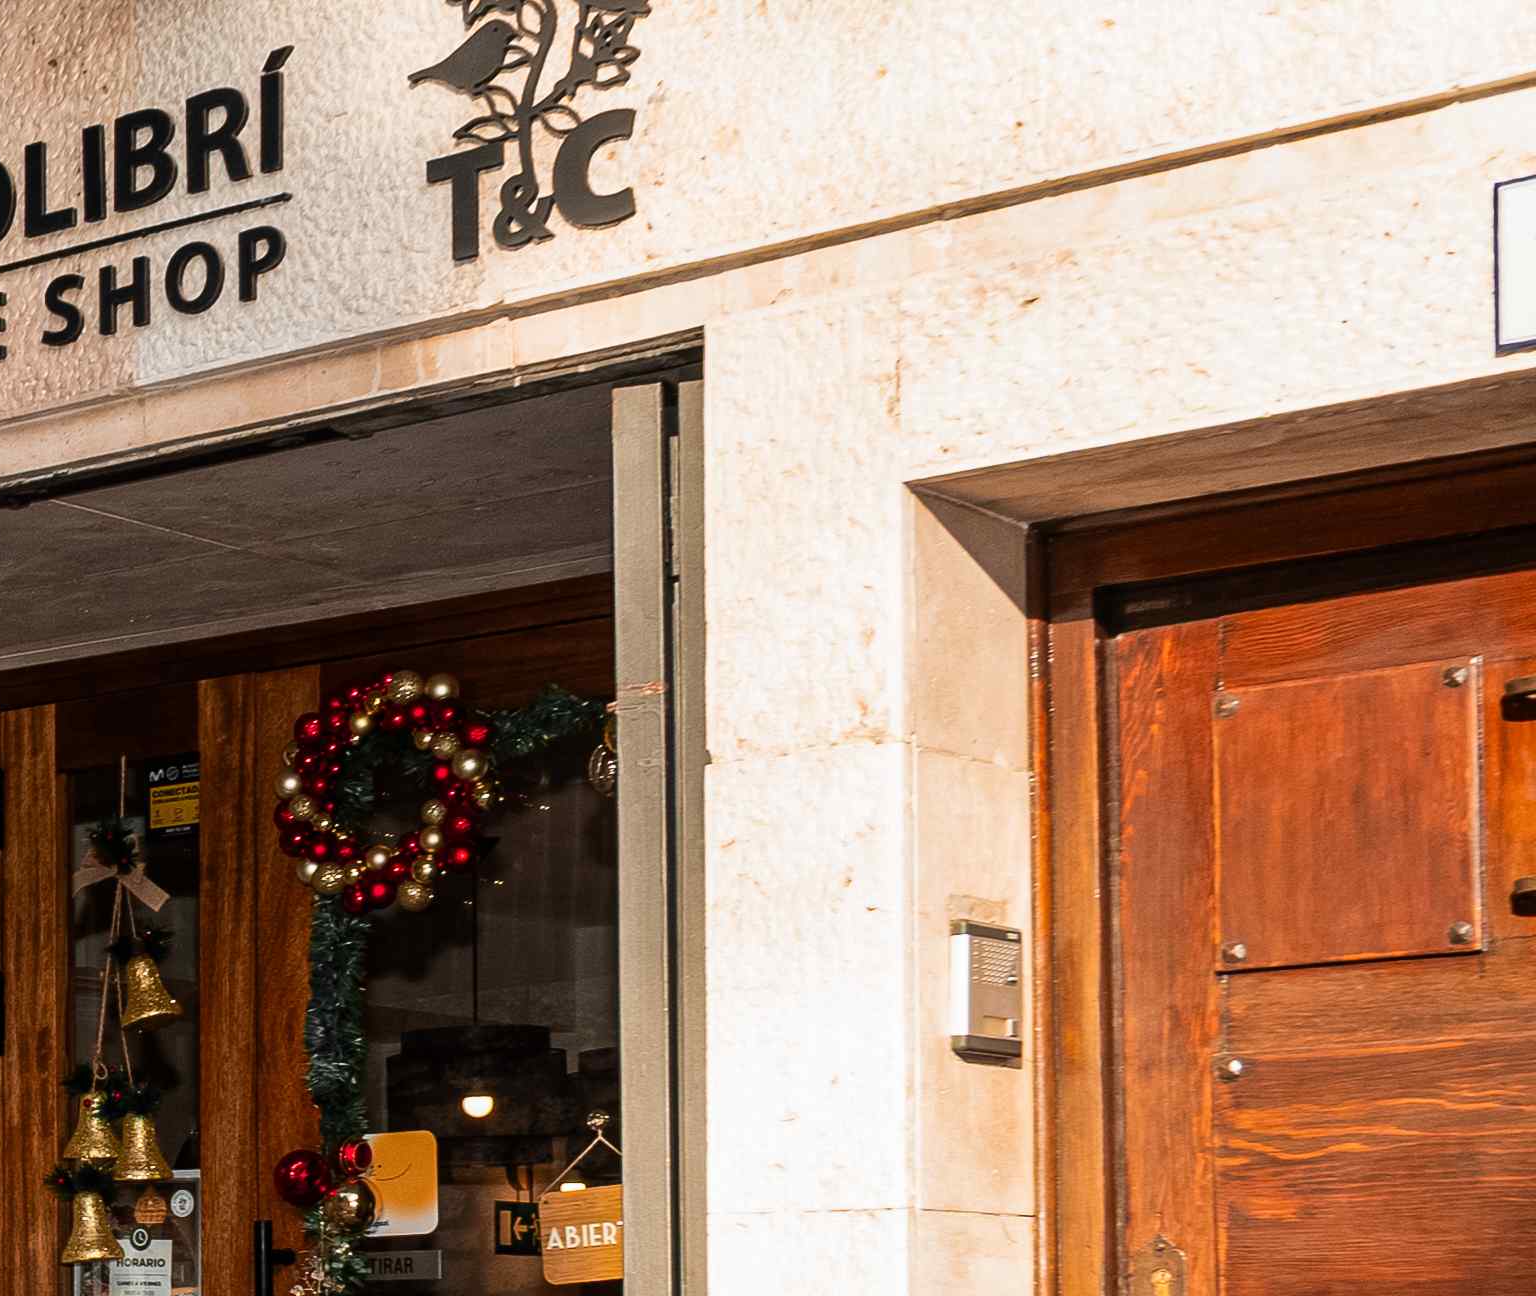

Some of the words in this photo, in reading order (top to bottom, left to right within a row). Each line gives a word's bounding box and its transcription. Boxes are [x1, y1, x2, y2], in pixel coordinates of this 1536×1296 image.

[426, 108, 636, 261] T&C
[41, 226, 286, 346] SHOP
[546, 1221, 623, 1250] ABIER
